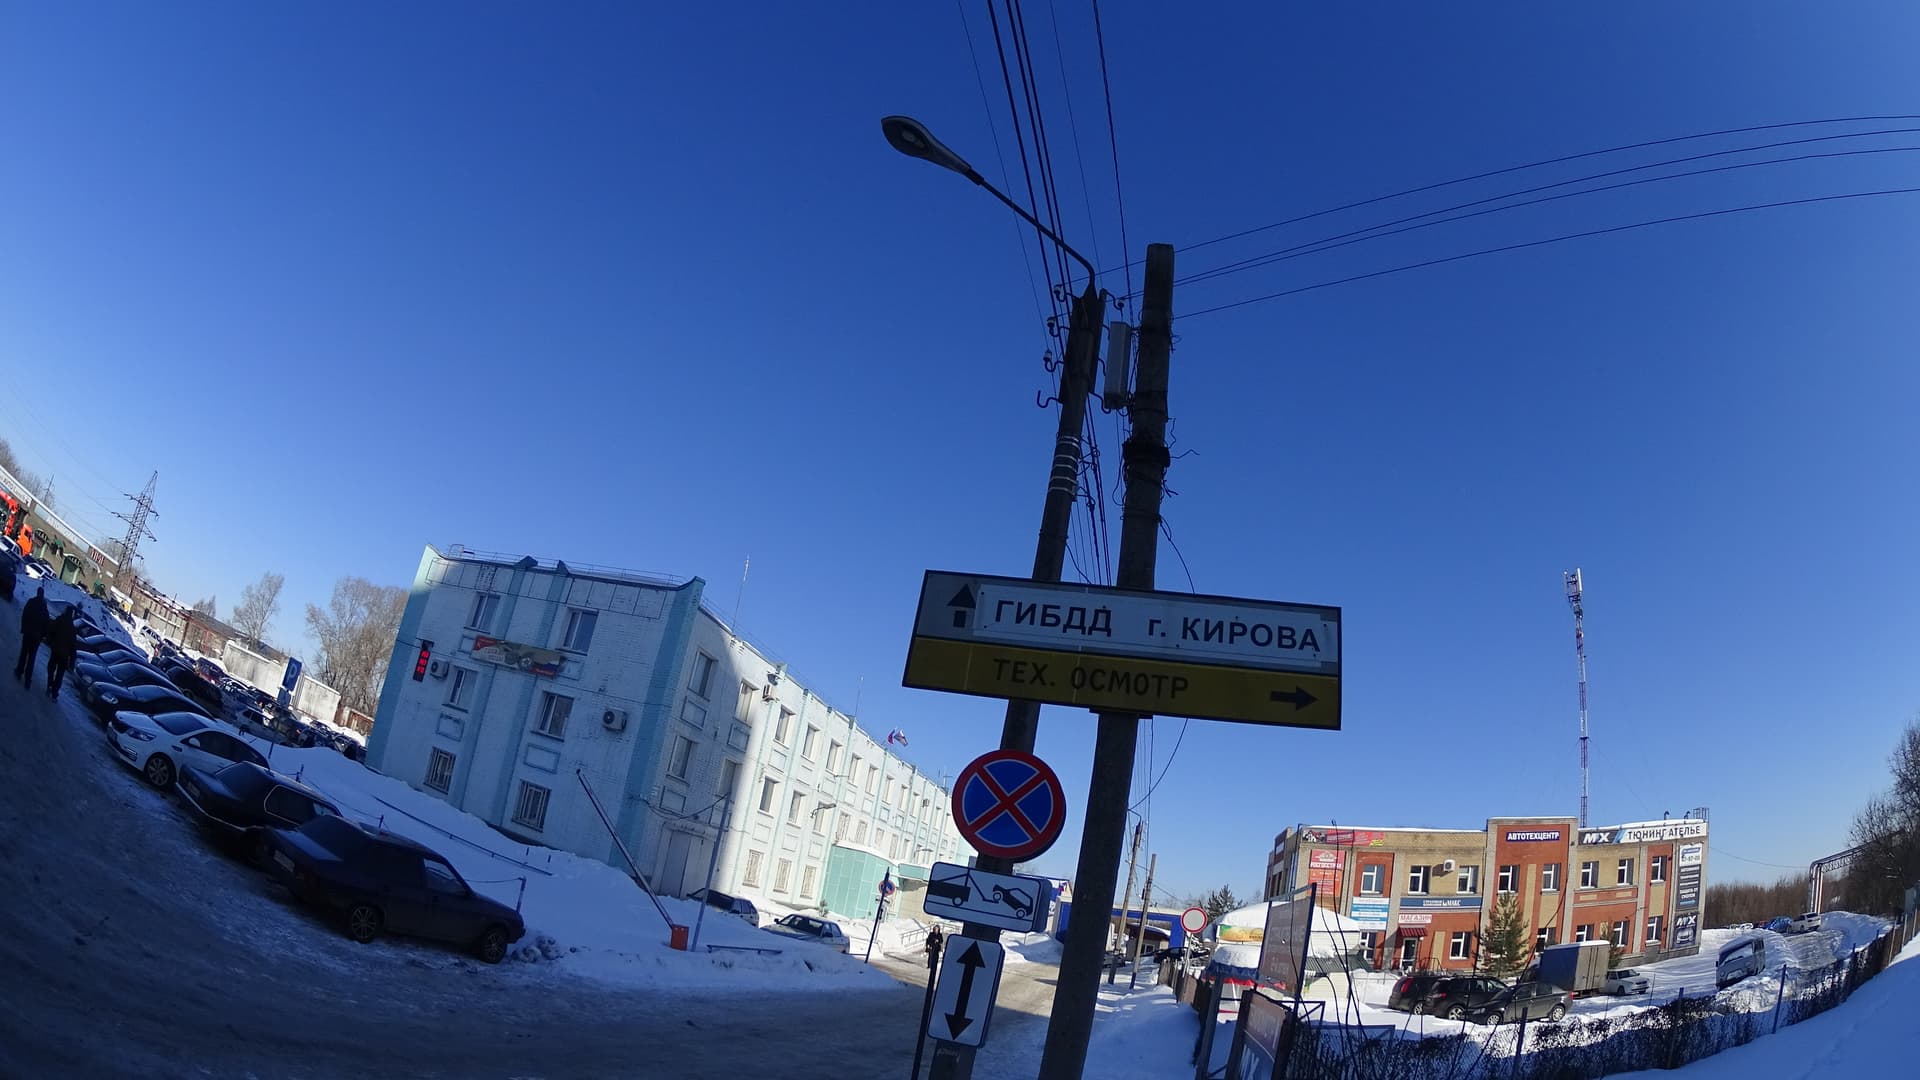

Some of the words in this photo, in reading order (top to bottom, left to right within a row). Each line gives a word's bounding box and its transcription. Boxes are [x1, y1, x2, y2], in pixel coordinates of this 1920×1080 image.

[994, 600, 1112, 637] ГИБДД
[1148, 619, 1167, 638] г.
[1181, 616, 1321, 652] КИРОВА
[993, 658, 1056, 687] ТЕХ.
[1070, 666, 1189, 699] ОСМОТР
[1507, 832, 1560, 840] АВТОТЕХЦЕНТР
[1628, 829, 1667, 840] ТЮНИНГ
[1668, 826, 1701, 837] АТЕЛЬЕ
